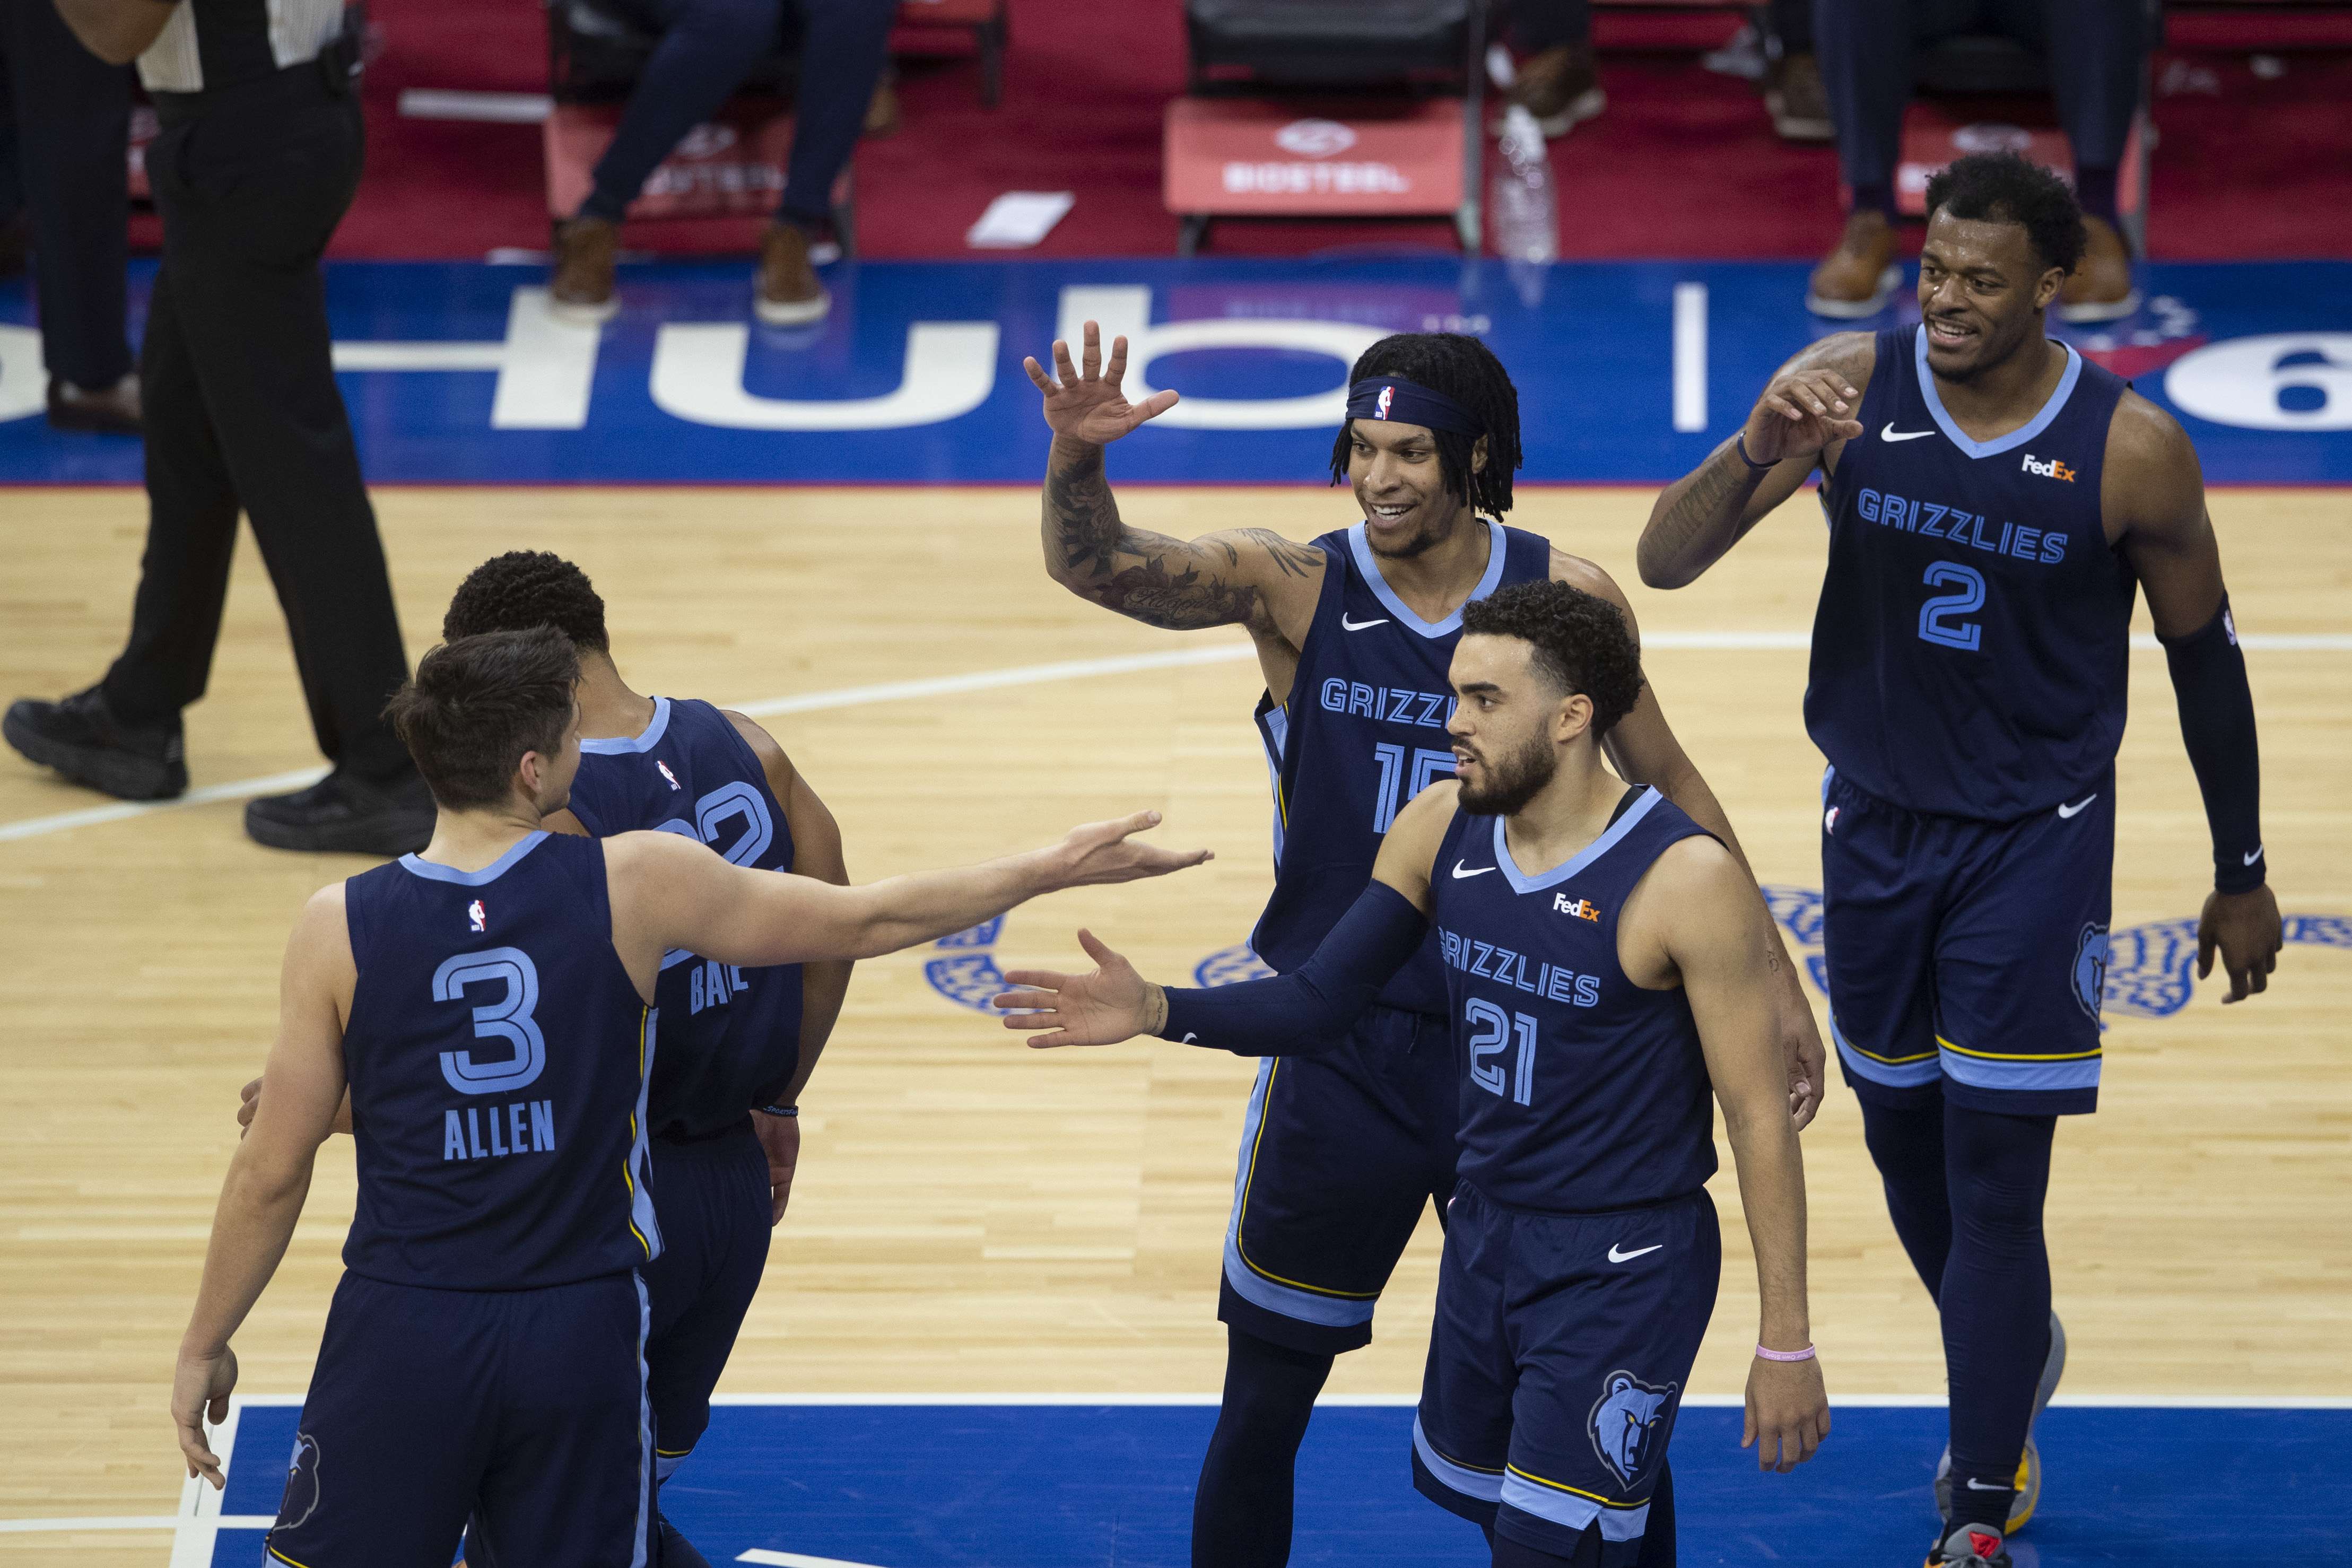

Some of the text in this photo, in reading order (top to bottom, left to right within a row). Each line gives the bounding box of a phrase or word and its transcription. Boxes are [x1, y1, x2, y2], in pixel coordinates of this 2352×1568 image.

[2022, 454, 2076, 482] FedEx
[1858, 487, 2068, 564] GRIZZLIES
[1918, 560, 1986, 651] 2
[1321, 678, 1457, 729] GRIZZ
[1553, 892, 1601, 922] FedEx
[691, 959, 749, 1015] BA
[432, 946, 546, 1095] 3
[1466, 997, 1538, 1107] 21
[444, 1100, 555, 1160] ALLEN
